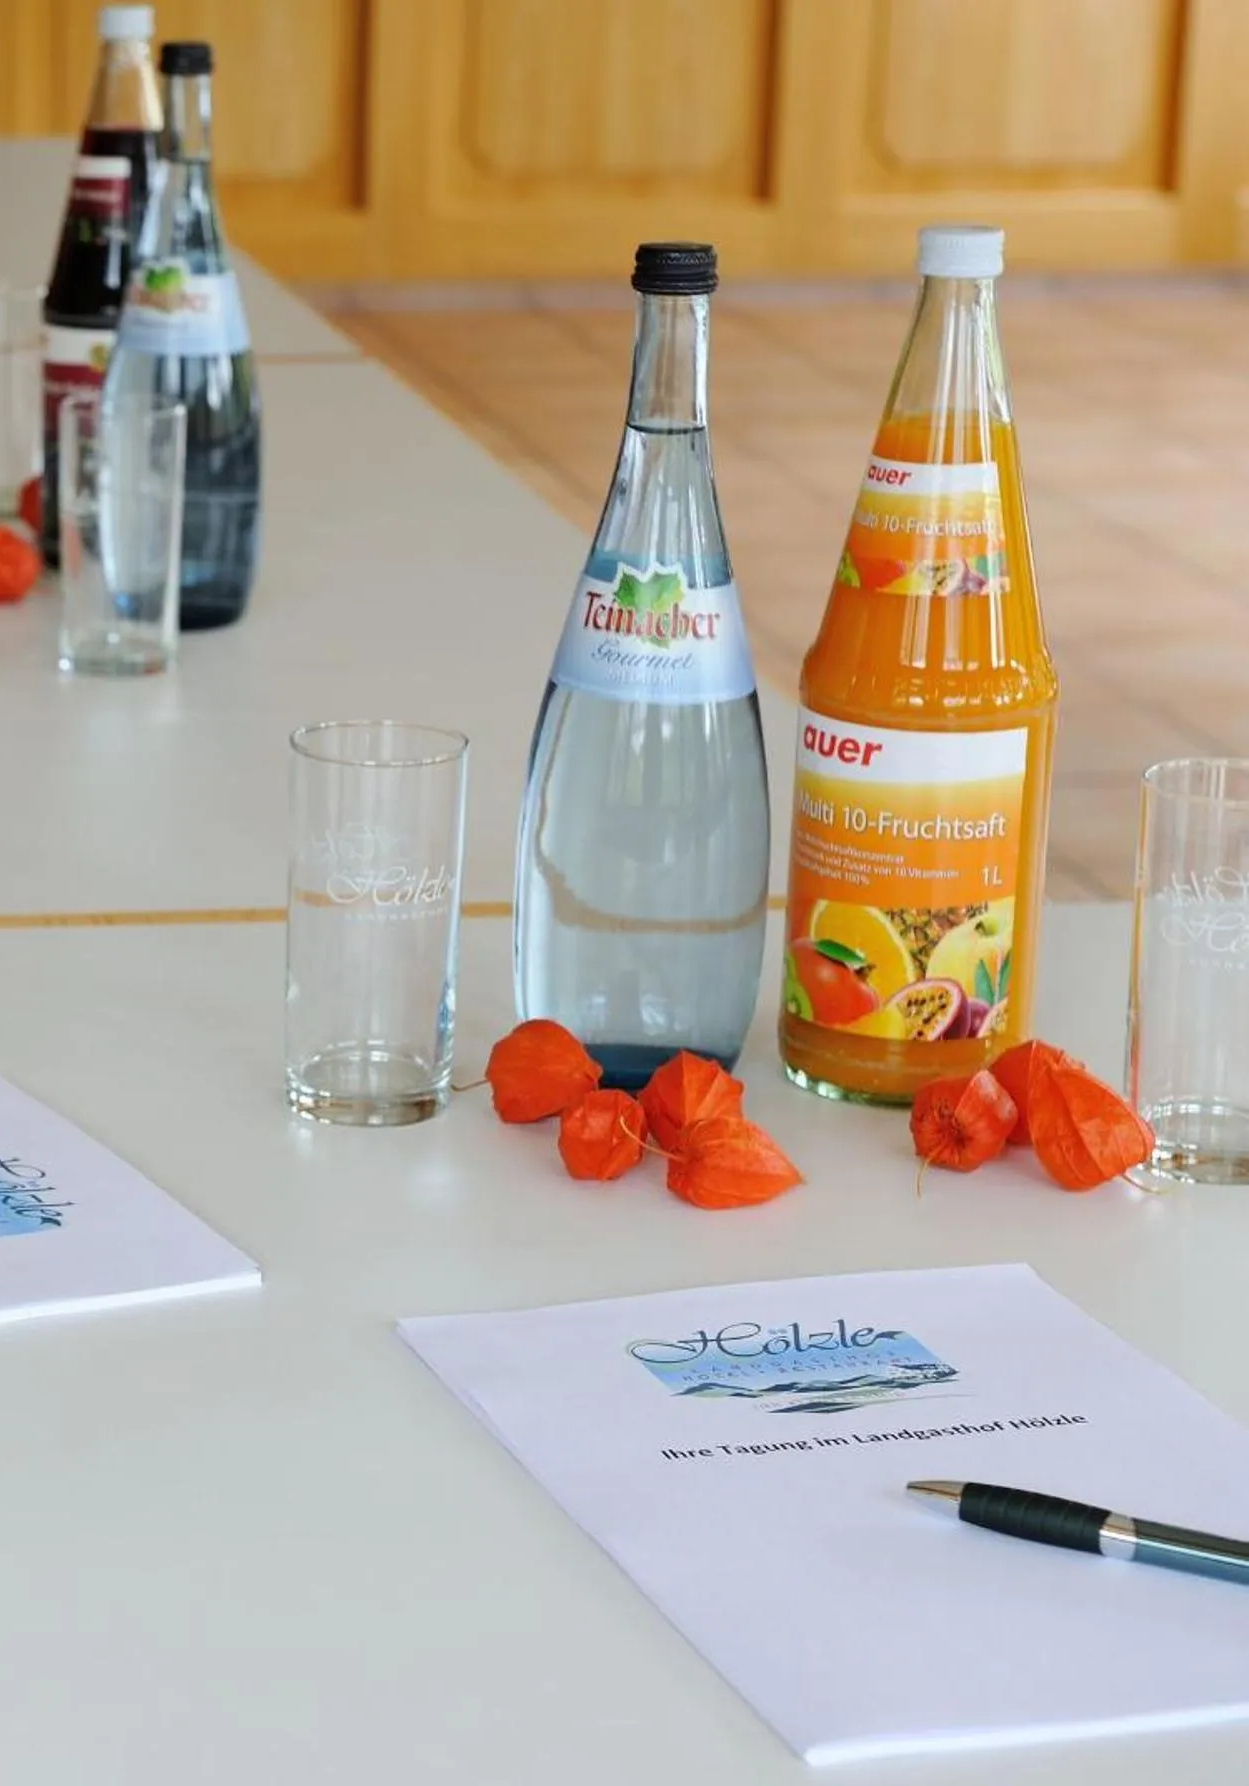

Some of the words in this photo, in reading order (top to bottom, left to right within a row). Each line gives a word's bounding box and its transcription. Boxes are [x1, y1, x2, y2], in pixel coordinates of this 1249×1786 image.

[867, 464, 911, 485] auer
[591, 638, 696, 670] Gourmet
[803, 723, 883, 768] auer
[842, 804, 1006, 840] 10-Fruchtsaft
[630, 1318, 904, 1364] Hölzle
[661, 1448, 715, 1461] Ihre
[716, 1439, 814, 1456] Tagung
[813, 1435, 851, 1448] im
[852, 1420, 1005, 1445] Landgasthof
[1008, 1412, 1089, 1431] Hölzle
